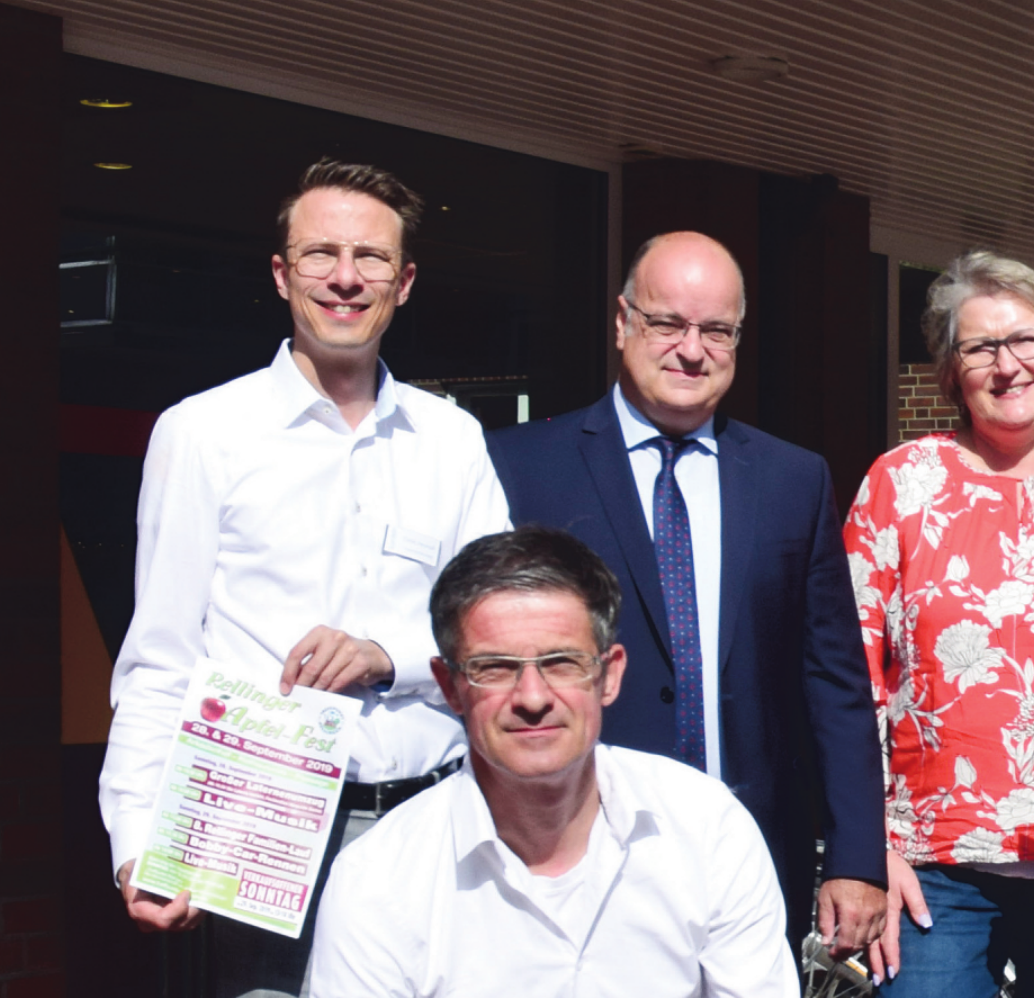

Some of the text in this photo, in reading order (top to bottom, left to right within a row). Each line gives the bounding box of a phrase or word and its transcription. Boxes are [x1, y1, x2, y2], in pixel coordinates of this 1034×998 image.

[205, 671, 302, 713] Rellinger
[191, 722, 333, 774] 28. & 29. September 2019
[220, 706, 336, 753] Apfel-Fest
[209, 771, 245, 788] Großer
[246, 780, 325, 809] Laternenumzug
[203, 793, 318, 832] Live-Musik
[184, 852, 238, 874] Live-Musik
[189, 836, 306, 875] Bobby-Car-Rennen
[239, 881, 302, 911] SONNTAG
